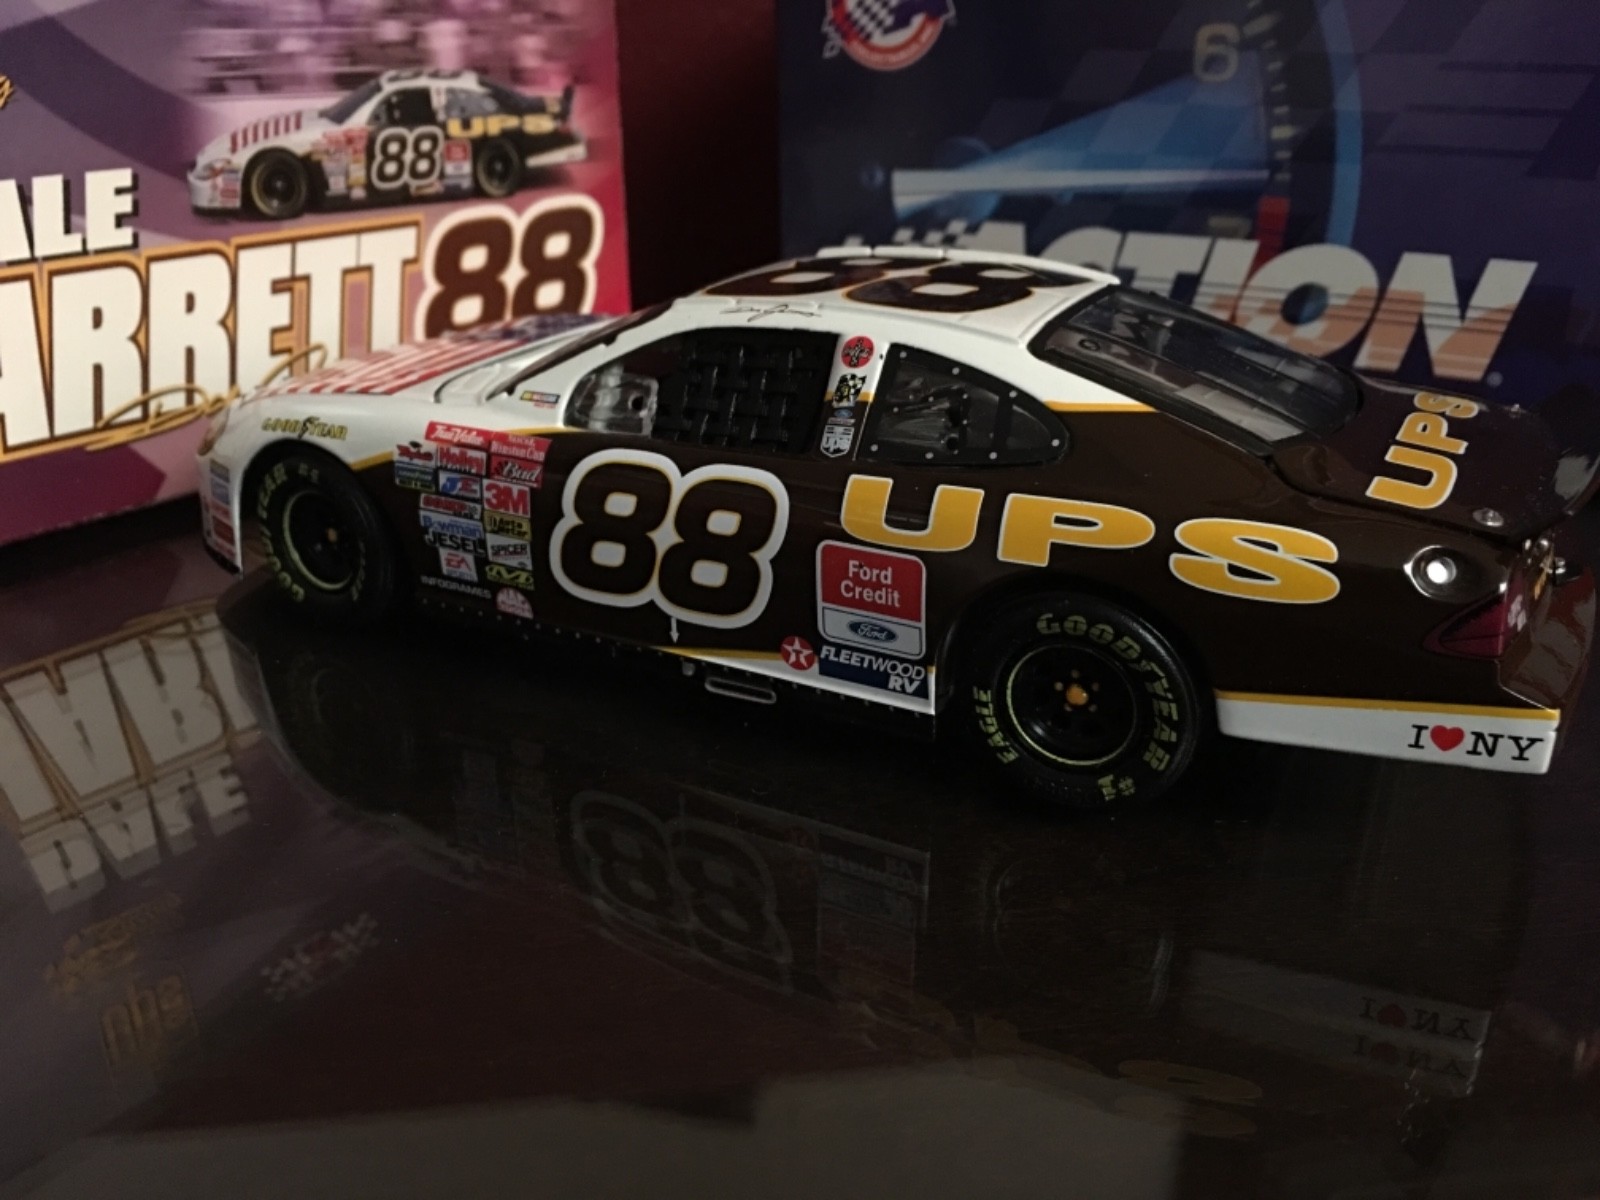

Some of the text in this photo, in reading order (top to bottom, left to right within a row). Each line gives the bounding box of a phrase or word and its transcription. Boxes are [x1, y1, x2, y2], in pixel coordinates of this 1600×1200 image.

[1193, 21, 1241, 83] 6
[446, 113, 556, 139] UPS
[371, 125, 444, 190] 88
[414, 194, 604, 342] 88
[1365, 392, 1479, 509] UPS
[502, 460, 540, 481] Bud
[485, 483, 529, 516] 3M
[424, 528, 487, 556] JESEL
[549, 448, 790, 629] 88
[840, 473, 1341, 604] UPS
[444, 551, 472, 572] EA
[848, 559, 893, 586] Ford
[840, 581, 901, 609] Credit
[820, 644, 925, 680] FLEETWOOD
[888, 674, 921, 694] RV
[1036, 612, 1179, 772] GOODYEAR
[1407, 723, 1544, 763] I NY
